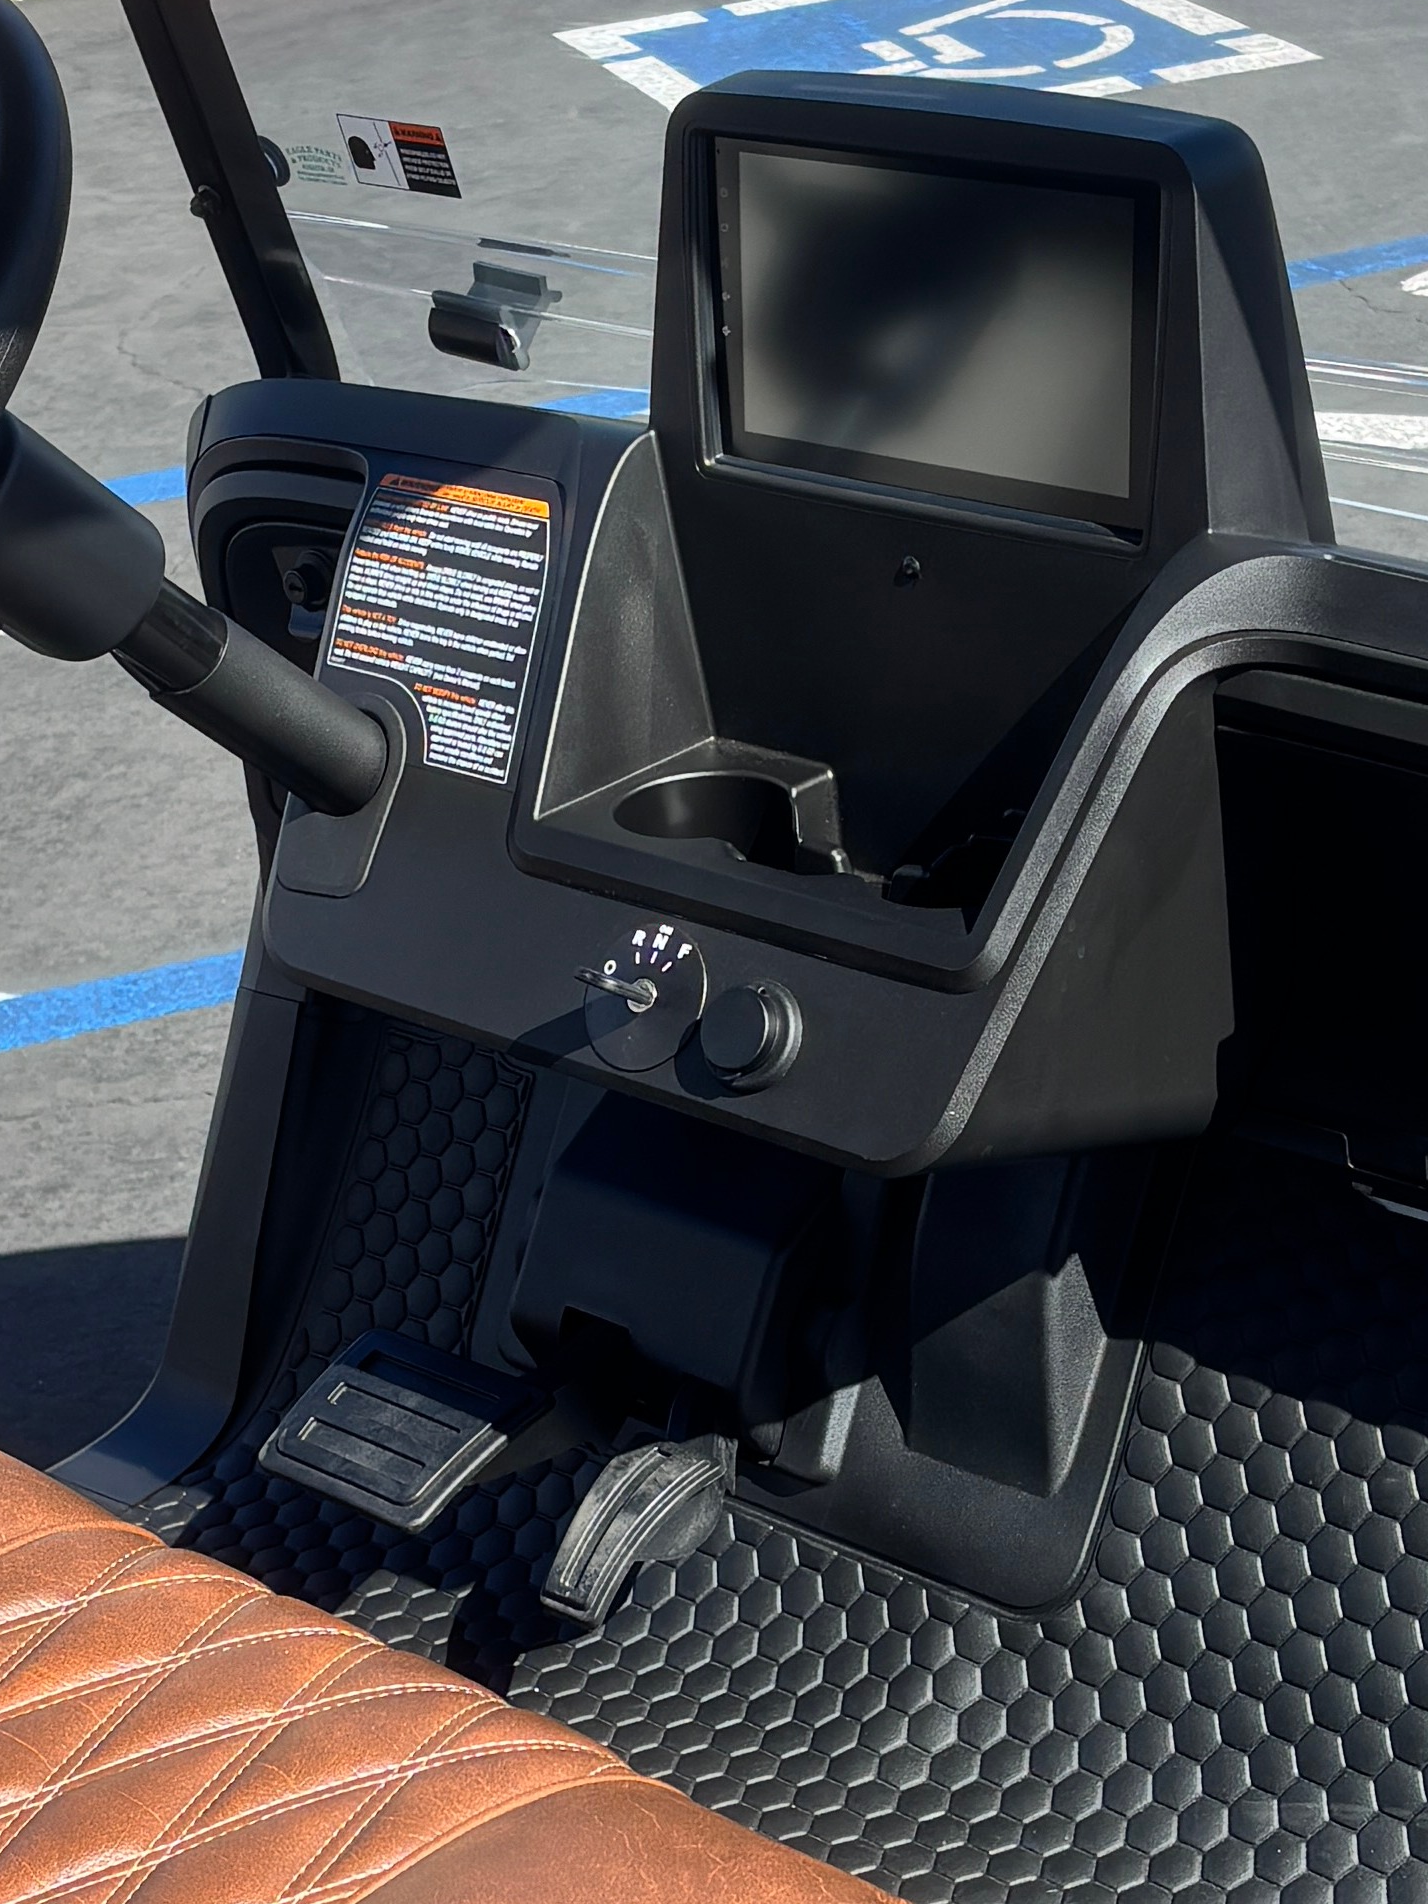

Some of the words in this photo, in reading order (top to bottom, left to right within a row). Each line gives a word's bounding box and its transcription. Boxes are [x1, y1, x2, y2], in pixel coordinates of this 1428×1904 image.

[632, 929, 646, 946] R
[652, 933, 669, 950] N
[677, 943, 693, 959] F
